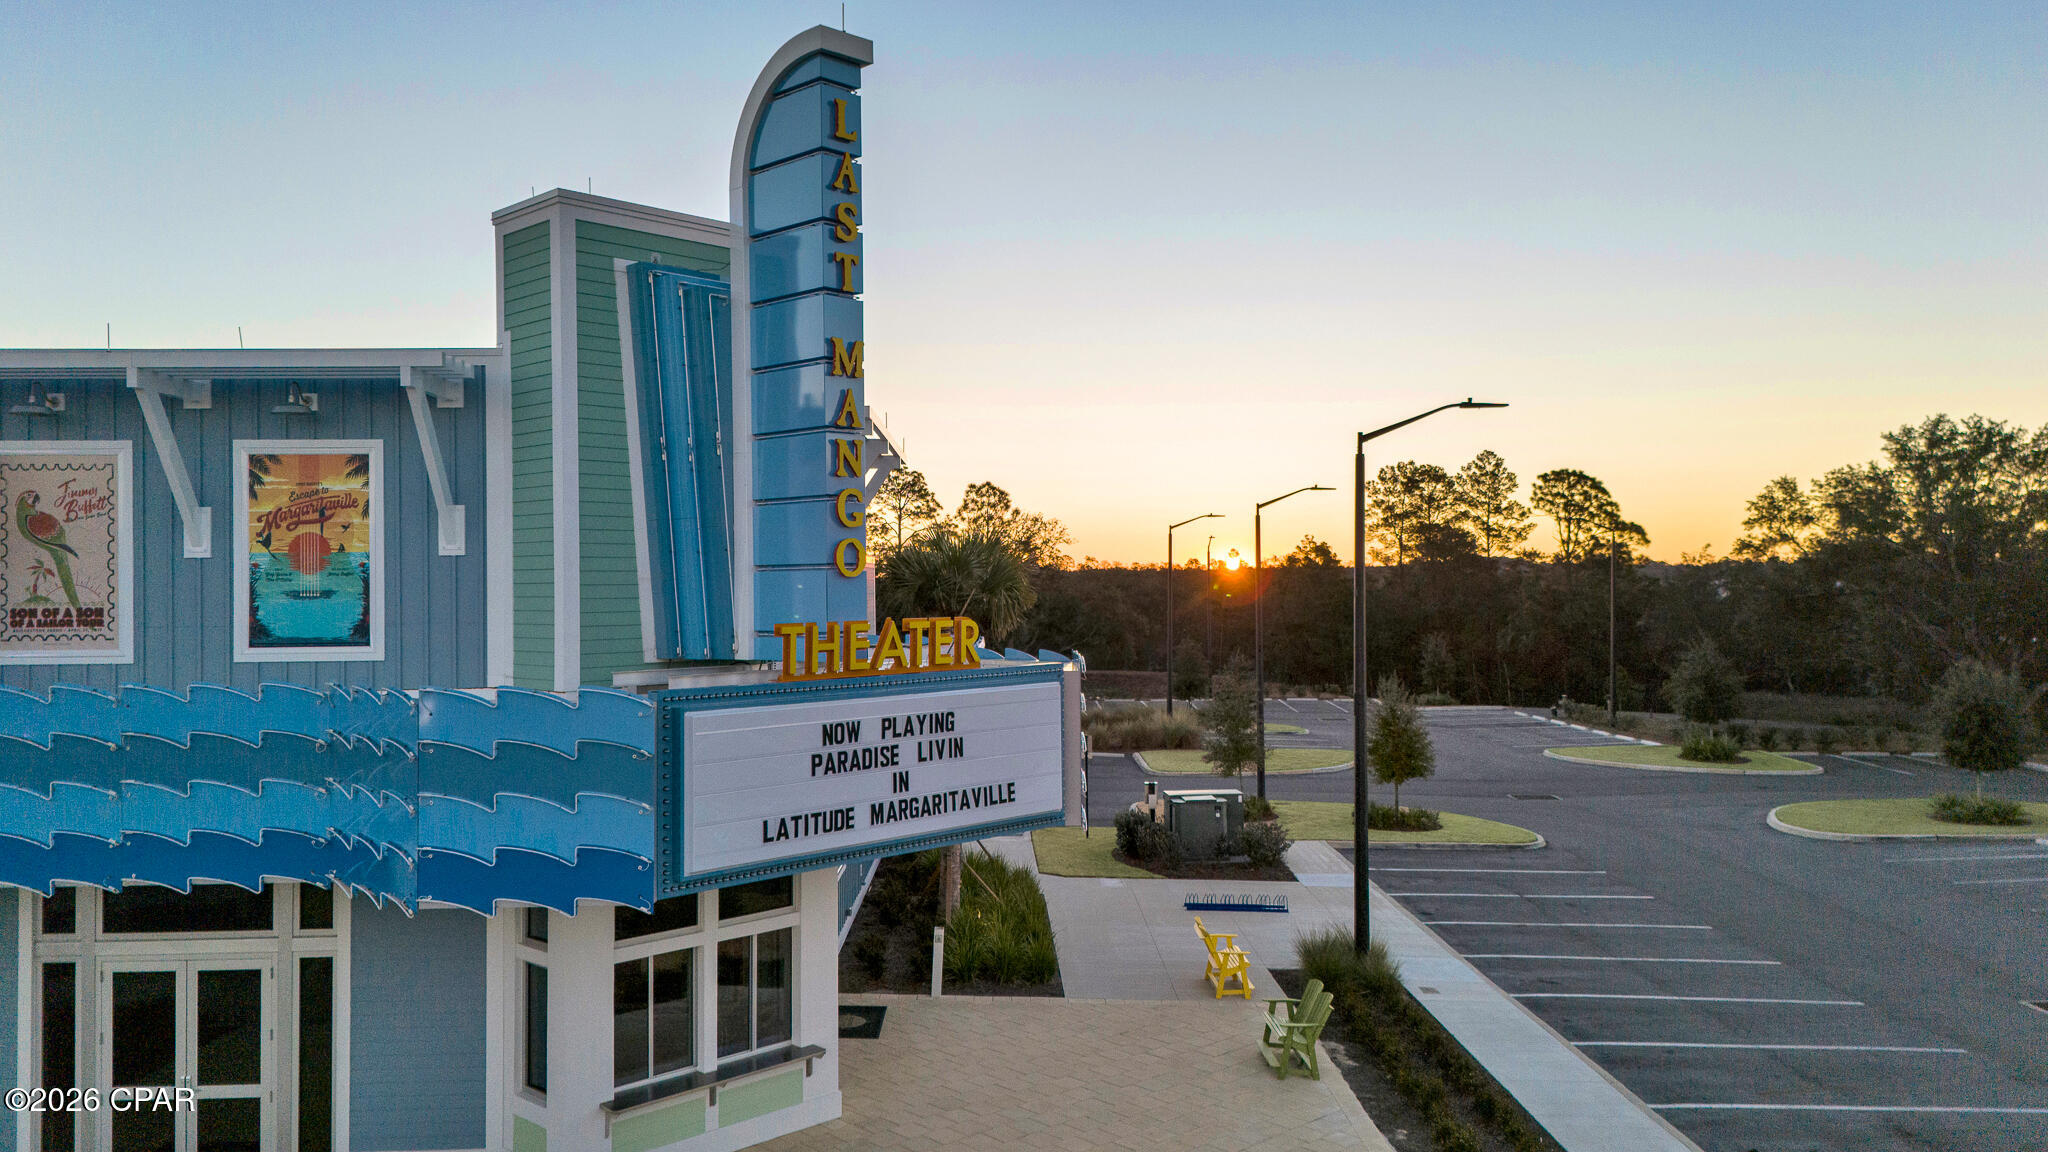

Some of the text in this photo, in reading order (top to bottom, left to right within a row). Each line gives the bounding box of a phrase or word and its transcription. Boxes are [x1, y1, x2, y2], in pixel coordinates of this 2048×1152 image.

[830, 97, 867, 578] LAST MANGO
[54, 478, 98, 508] Jimmy
[63, 495, 107, 523] Buffett
[288, 486, 329, 502] Escape to
[256, 492, 360, 533] Margaritaville
[9, 607, 105, 619] SON OF A SON
[9, 619, 25, 629] OF
[774, 616, 981, 680] THEATER
[821, 711, 955, 747] NOW PLAYING
[811, 736, 964, 777] PARADISE LIVIN
[892, 770, 910, 794] IN
[762, 782, 1016, 844] LATITUDE MARGARITAVILLE
